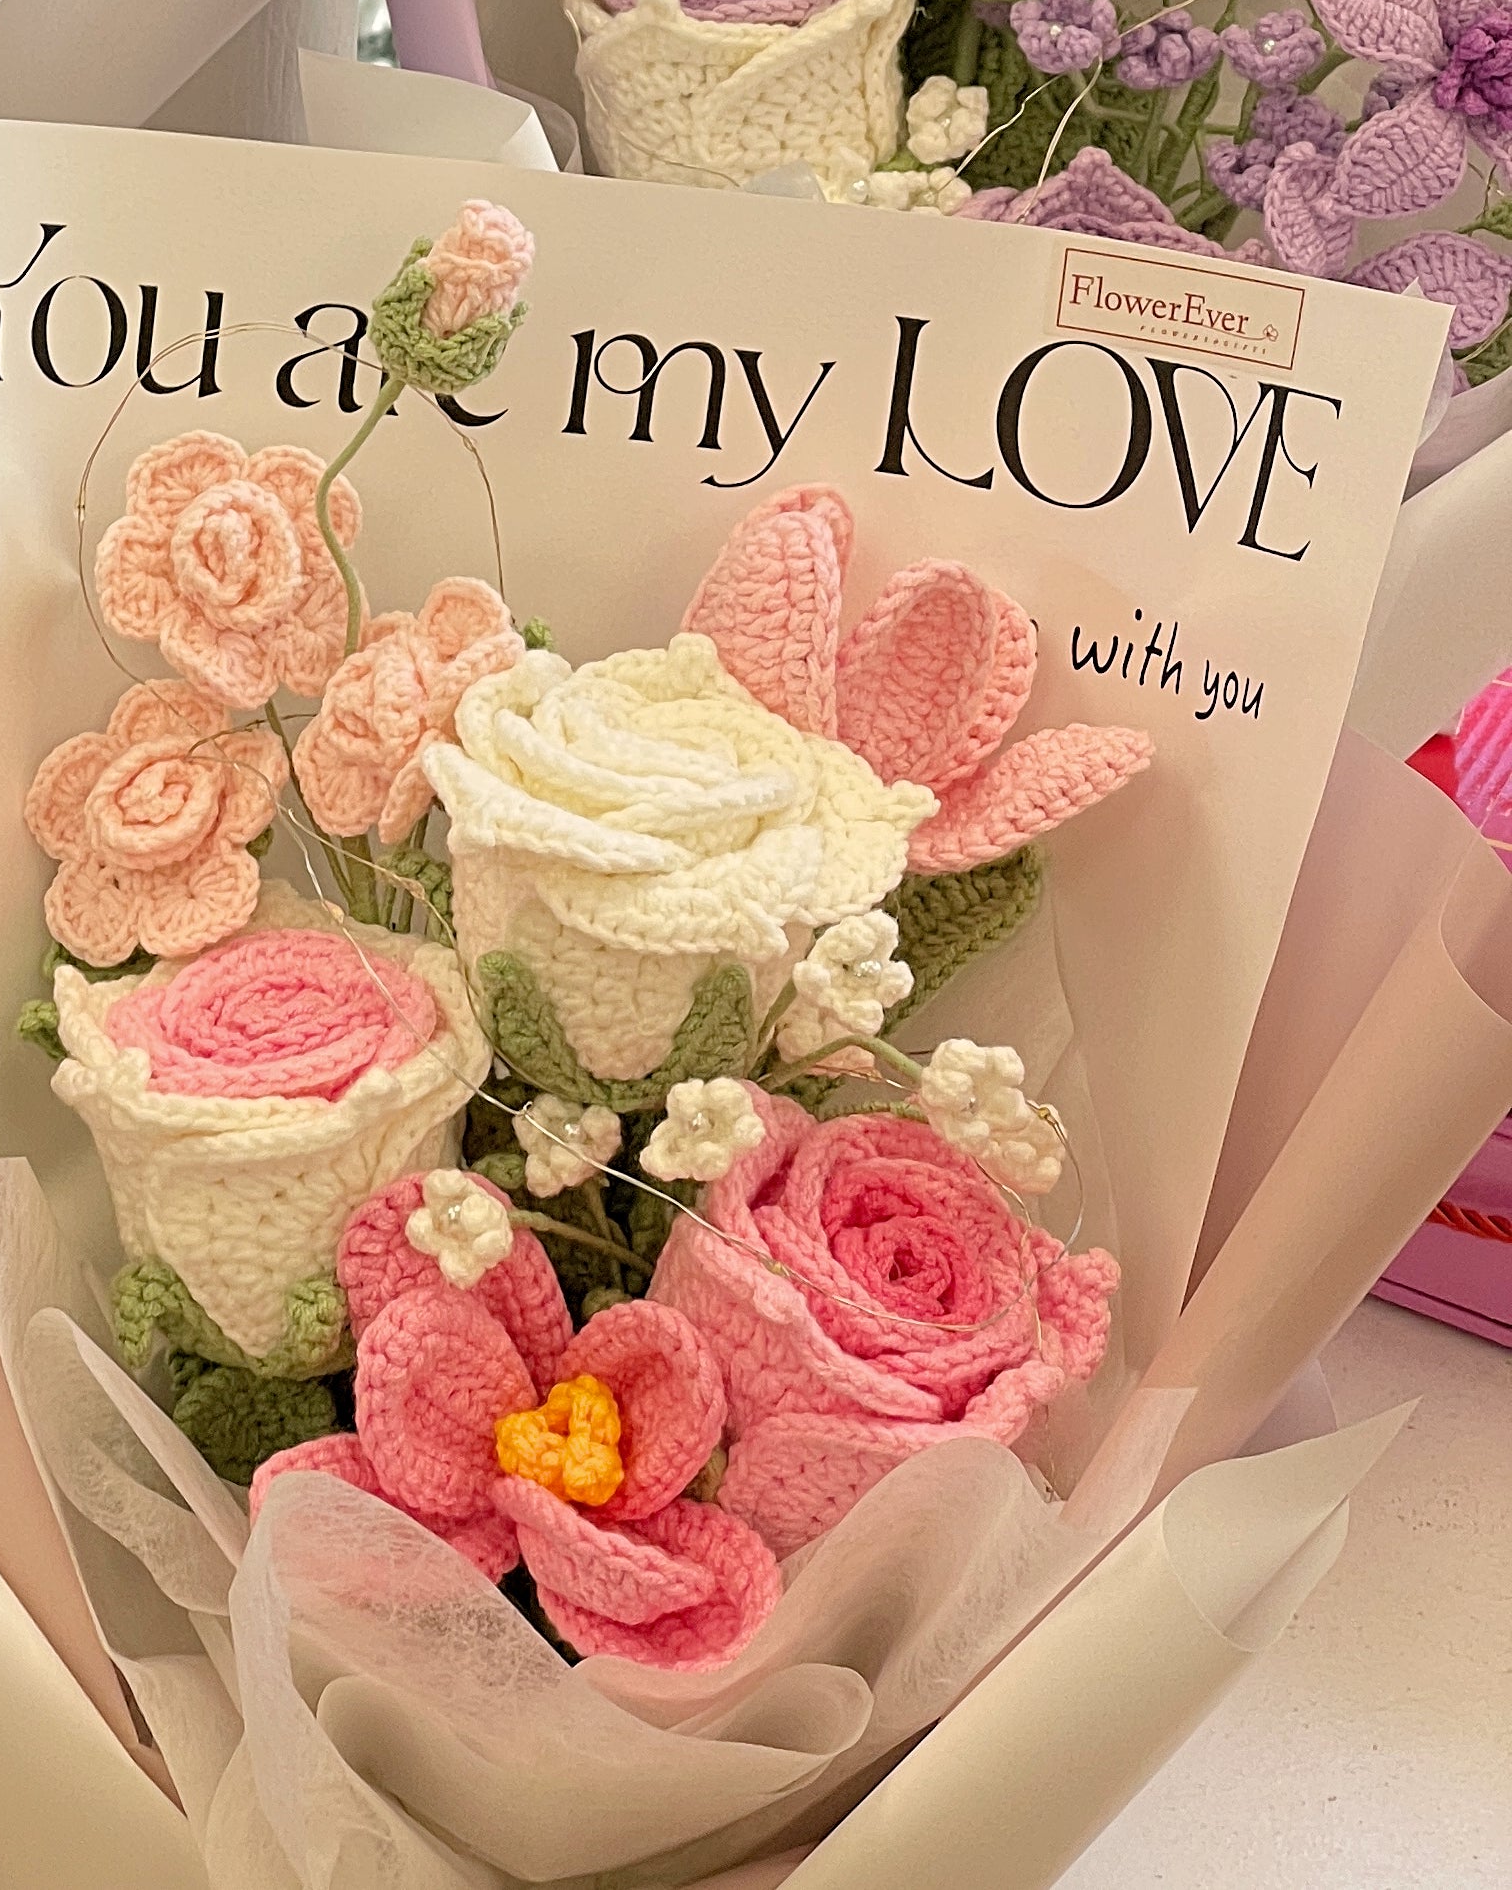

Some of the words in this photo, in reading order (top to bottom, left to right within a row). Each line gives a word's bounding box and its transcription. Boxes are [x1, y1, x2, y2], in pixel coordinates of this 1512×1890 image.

[1069, 273, 1249, 335] FlowerEver
[561, 328, 837, 488] my
[874, 315, 1343, 562] LOVE
[1071, 608, 1183, 695] with
[1194, 659, 1265, 720] you
